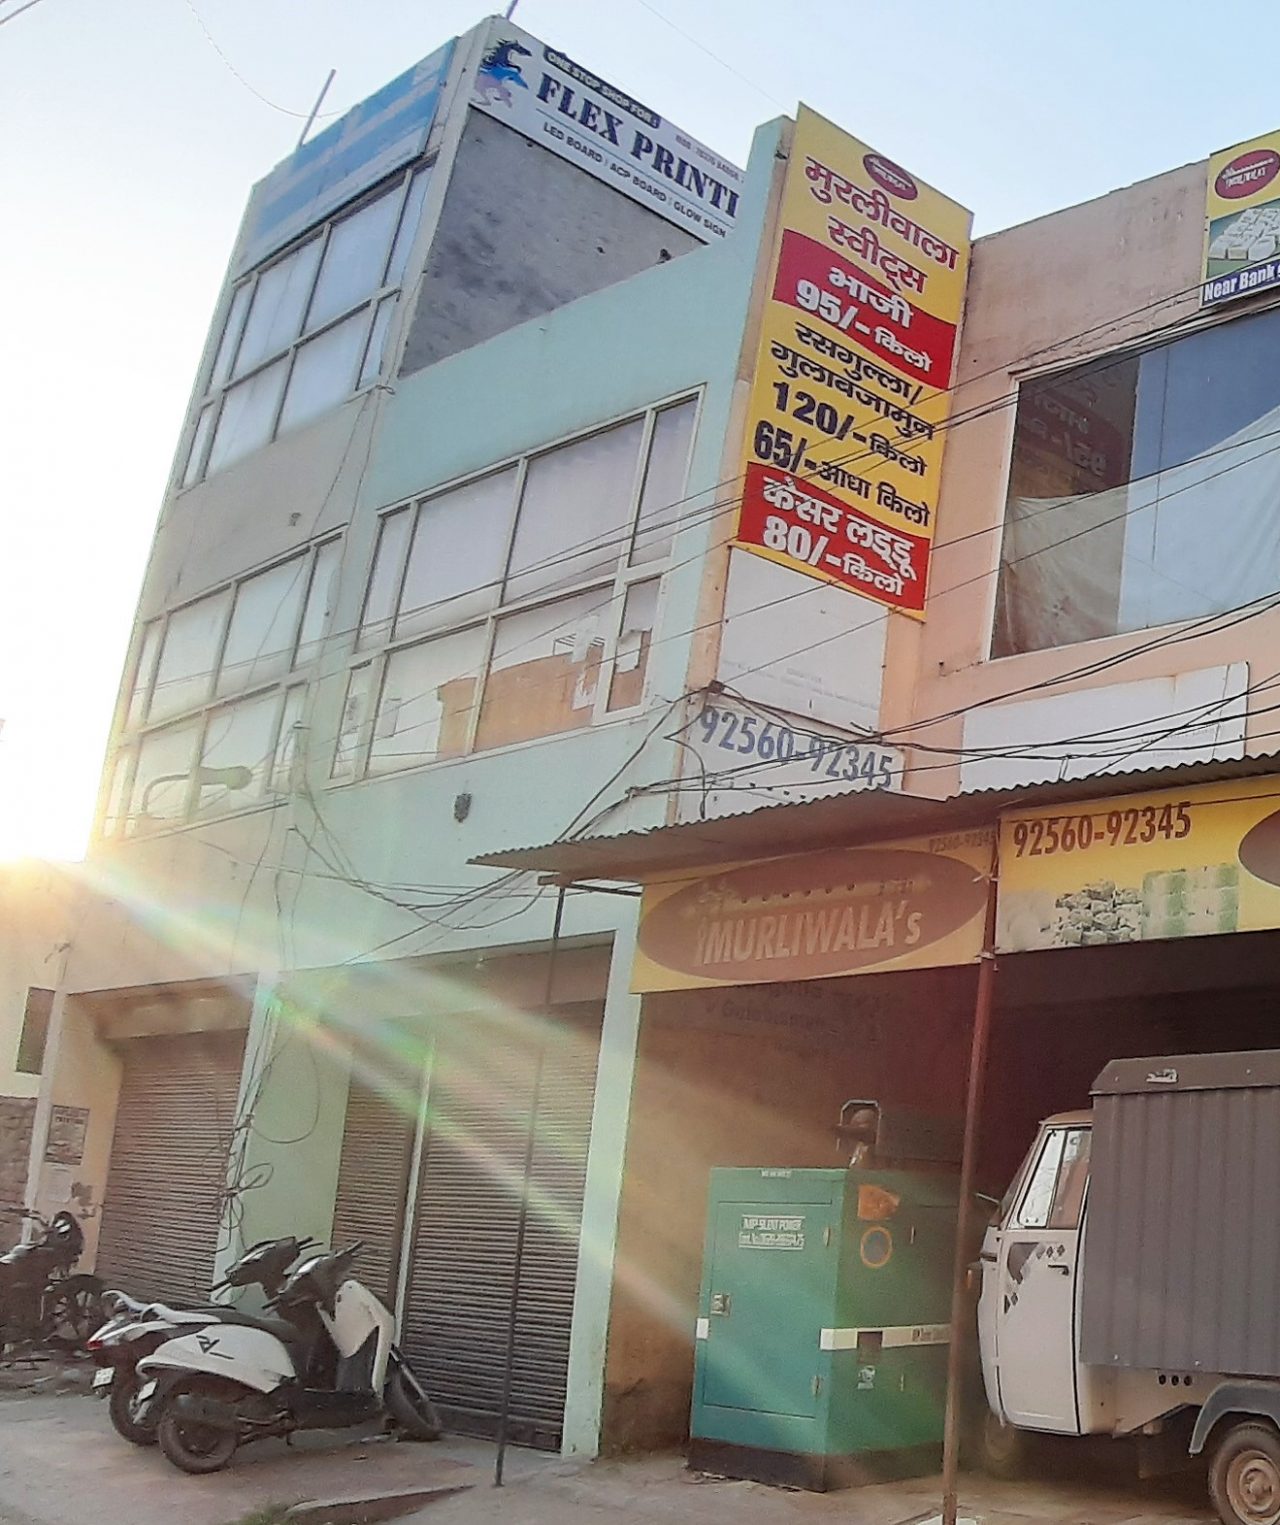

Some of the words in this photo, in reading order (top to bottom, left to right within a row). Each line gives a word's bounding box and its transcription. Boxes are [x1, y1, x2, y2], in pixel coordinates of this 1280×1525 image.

[536, 72, 623, 146] FLEX
[631, 130, 740, 219] PRINTI
[543, 121, 565, 141] LED
[566, 136, 603, 163] BOARD
[609, 162, 631, 179] ACP
[633, 176, 667, 202] BOARD
[673, 201, 702, 223] GLOW
[804, 156, 960, 271] मुरलीवाला
[828, 216, 928, 293] स्वीट्स
[1203, 278, 1238, 301] Near
[1239, 266, 1275, 290] Bank
[828, 266, 914, 328] भाजी
[763, 475, 843, 533] केसर
[876, 481, 930, 526] किलो
[701, 706, 893, 788] 92560-92345
[1013, 801, 1192, 858] 92560-92345
[703, 900, 923, 966] MURLIWALA's
